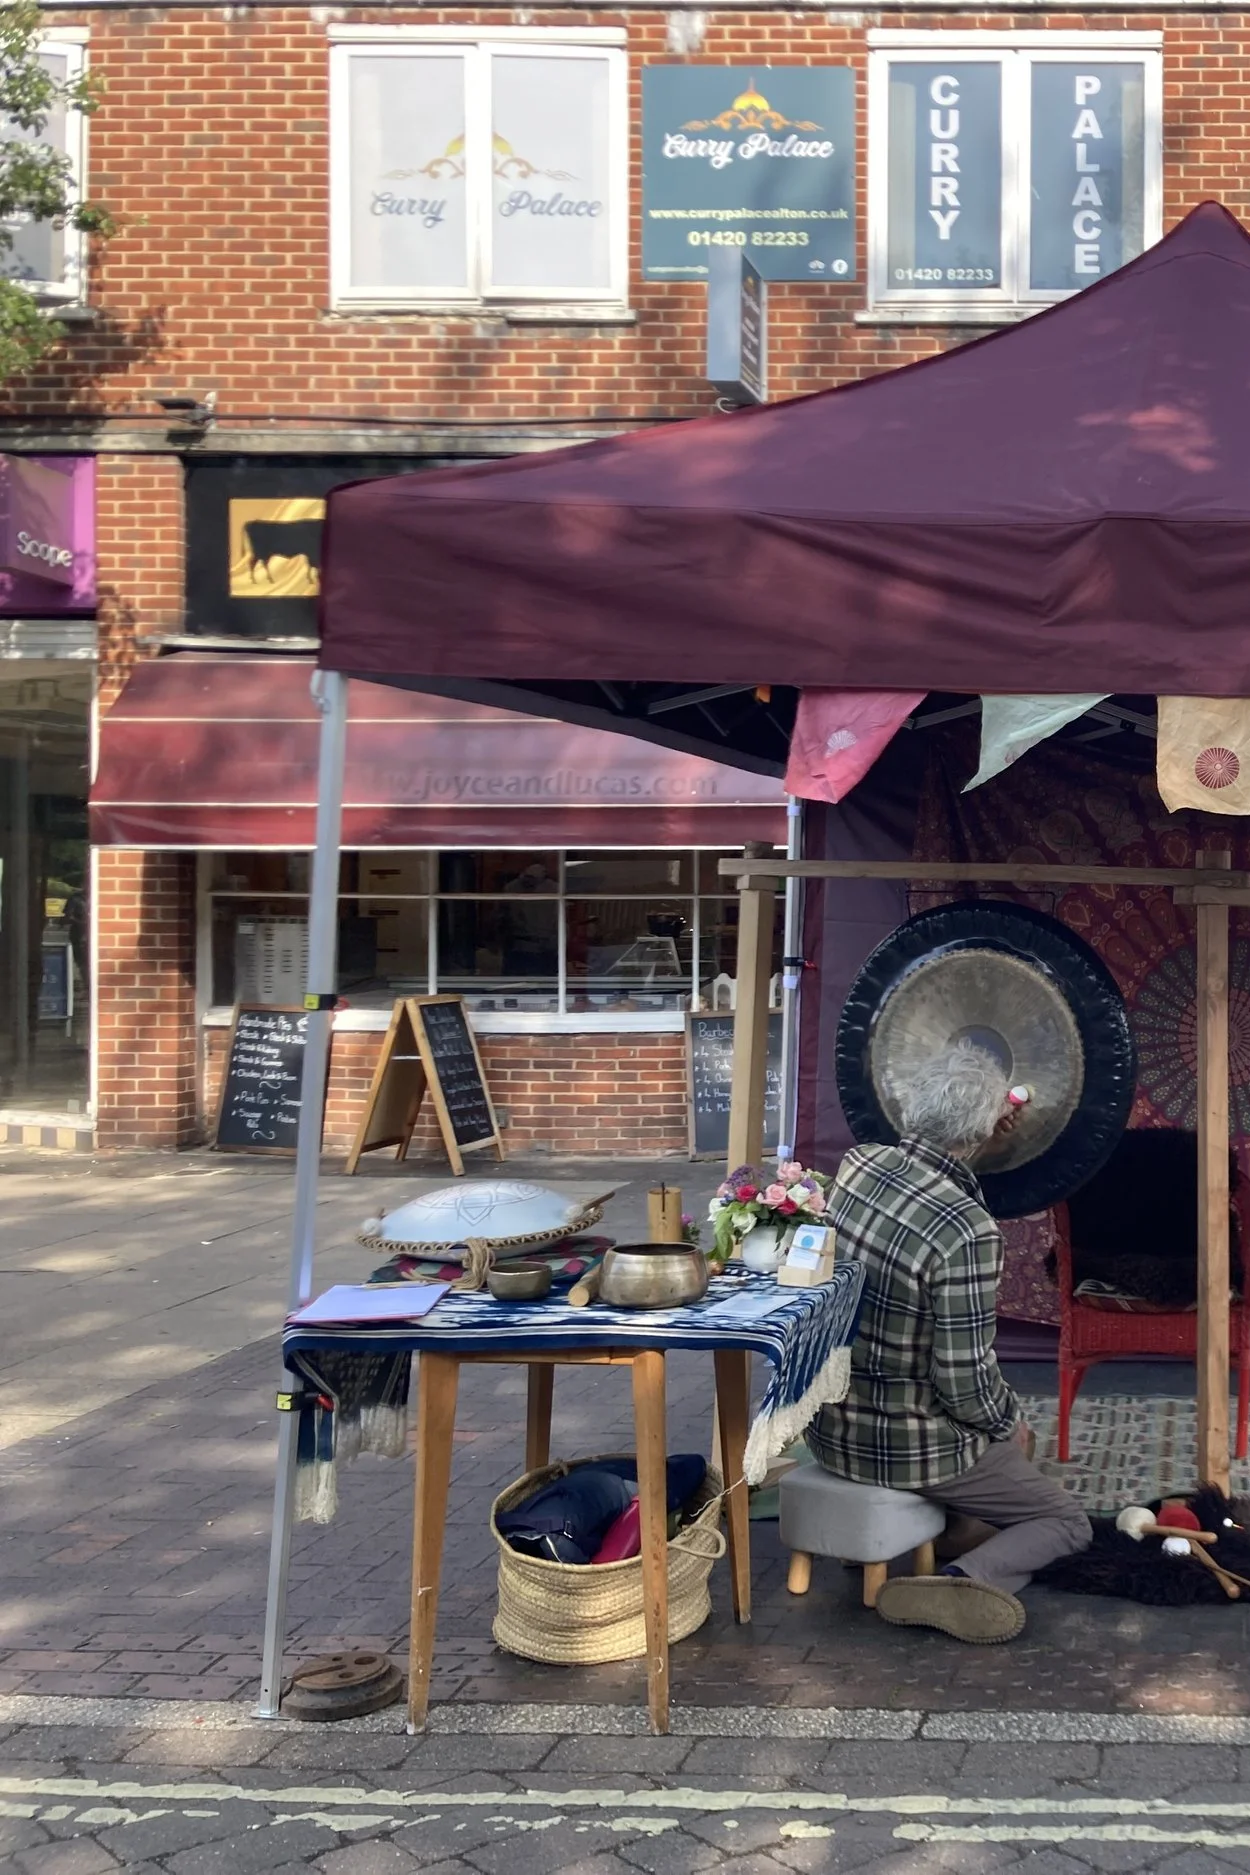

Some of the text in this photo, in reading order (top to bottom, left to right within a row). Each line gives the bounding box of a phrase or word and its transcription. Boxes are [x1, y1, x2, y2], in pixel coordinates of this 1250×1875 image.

[662, 132, 835, 169] Curry Palace
[929, 75, 960, 240] CURRY
[1071, 75, 1102, 274] PALACE
[369, 190, 602, 229] Curry Palace
[649, 208, 849, 221] www.currypalacealton.co.uk
[688, 231, 810, 246] 01420 82233
[894, 268, 994, 281] 01420 82233
[17, 531, 73, 567] Scope
